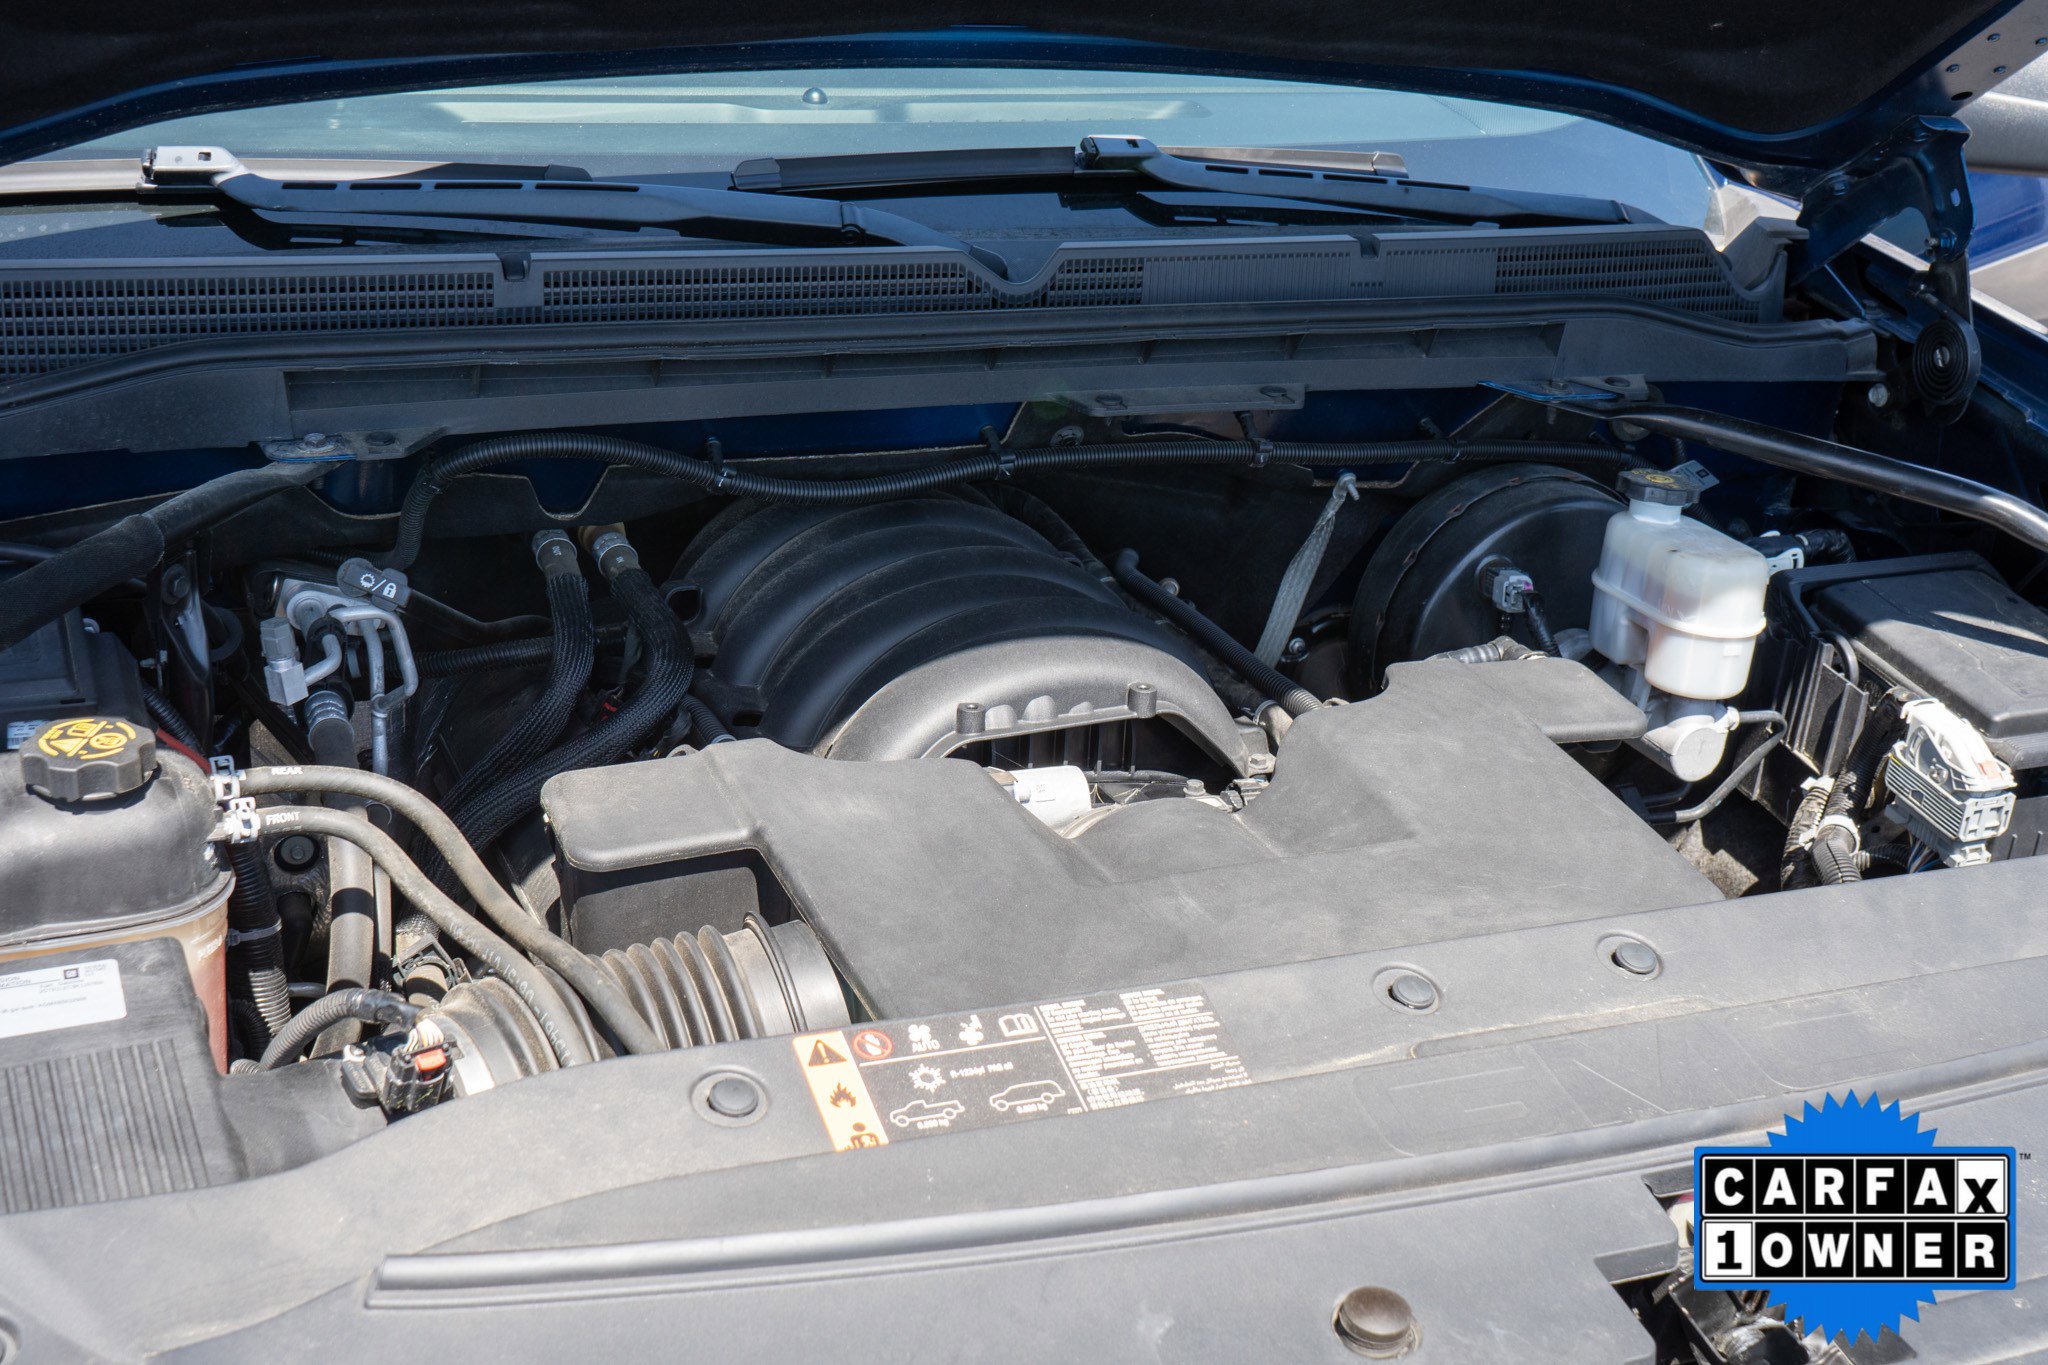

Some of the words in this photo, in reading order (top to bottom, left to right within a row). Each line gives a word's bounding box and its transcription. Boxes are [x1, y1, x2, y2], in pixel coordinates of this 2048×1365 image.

[271, 766, 304, 775] REAR
[266, 811, 301, 826] FRONT
[912, 1039, 940, 1052] AUTO
